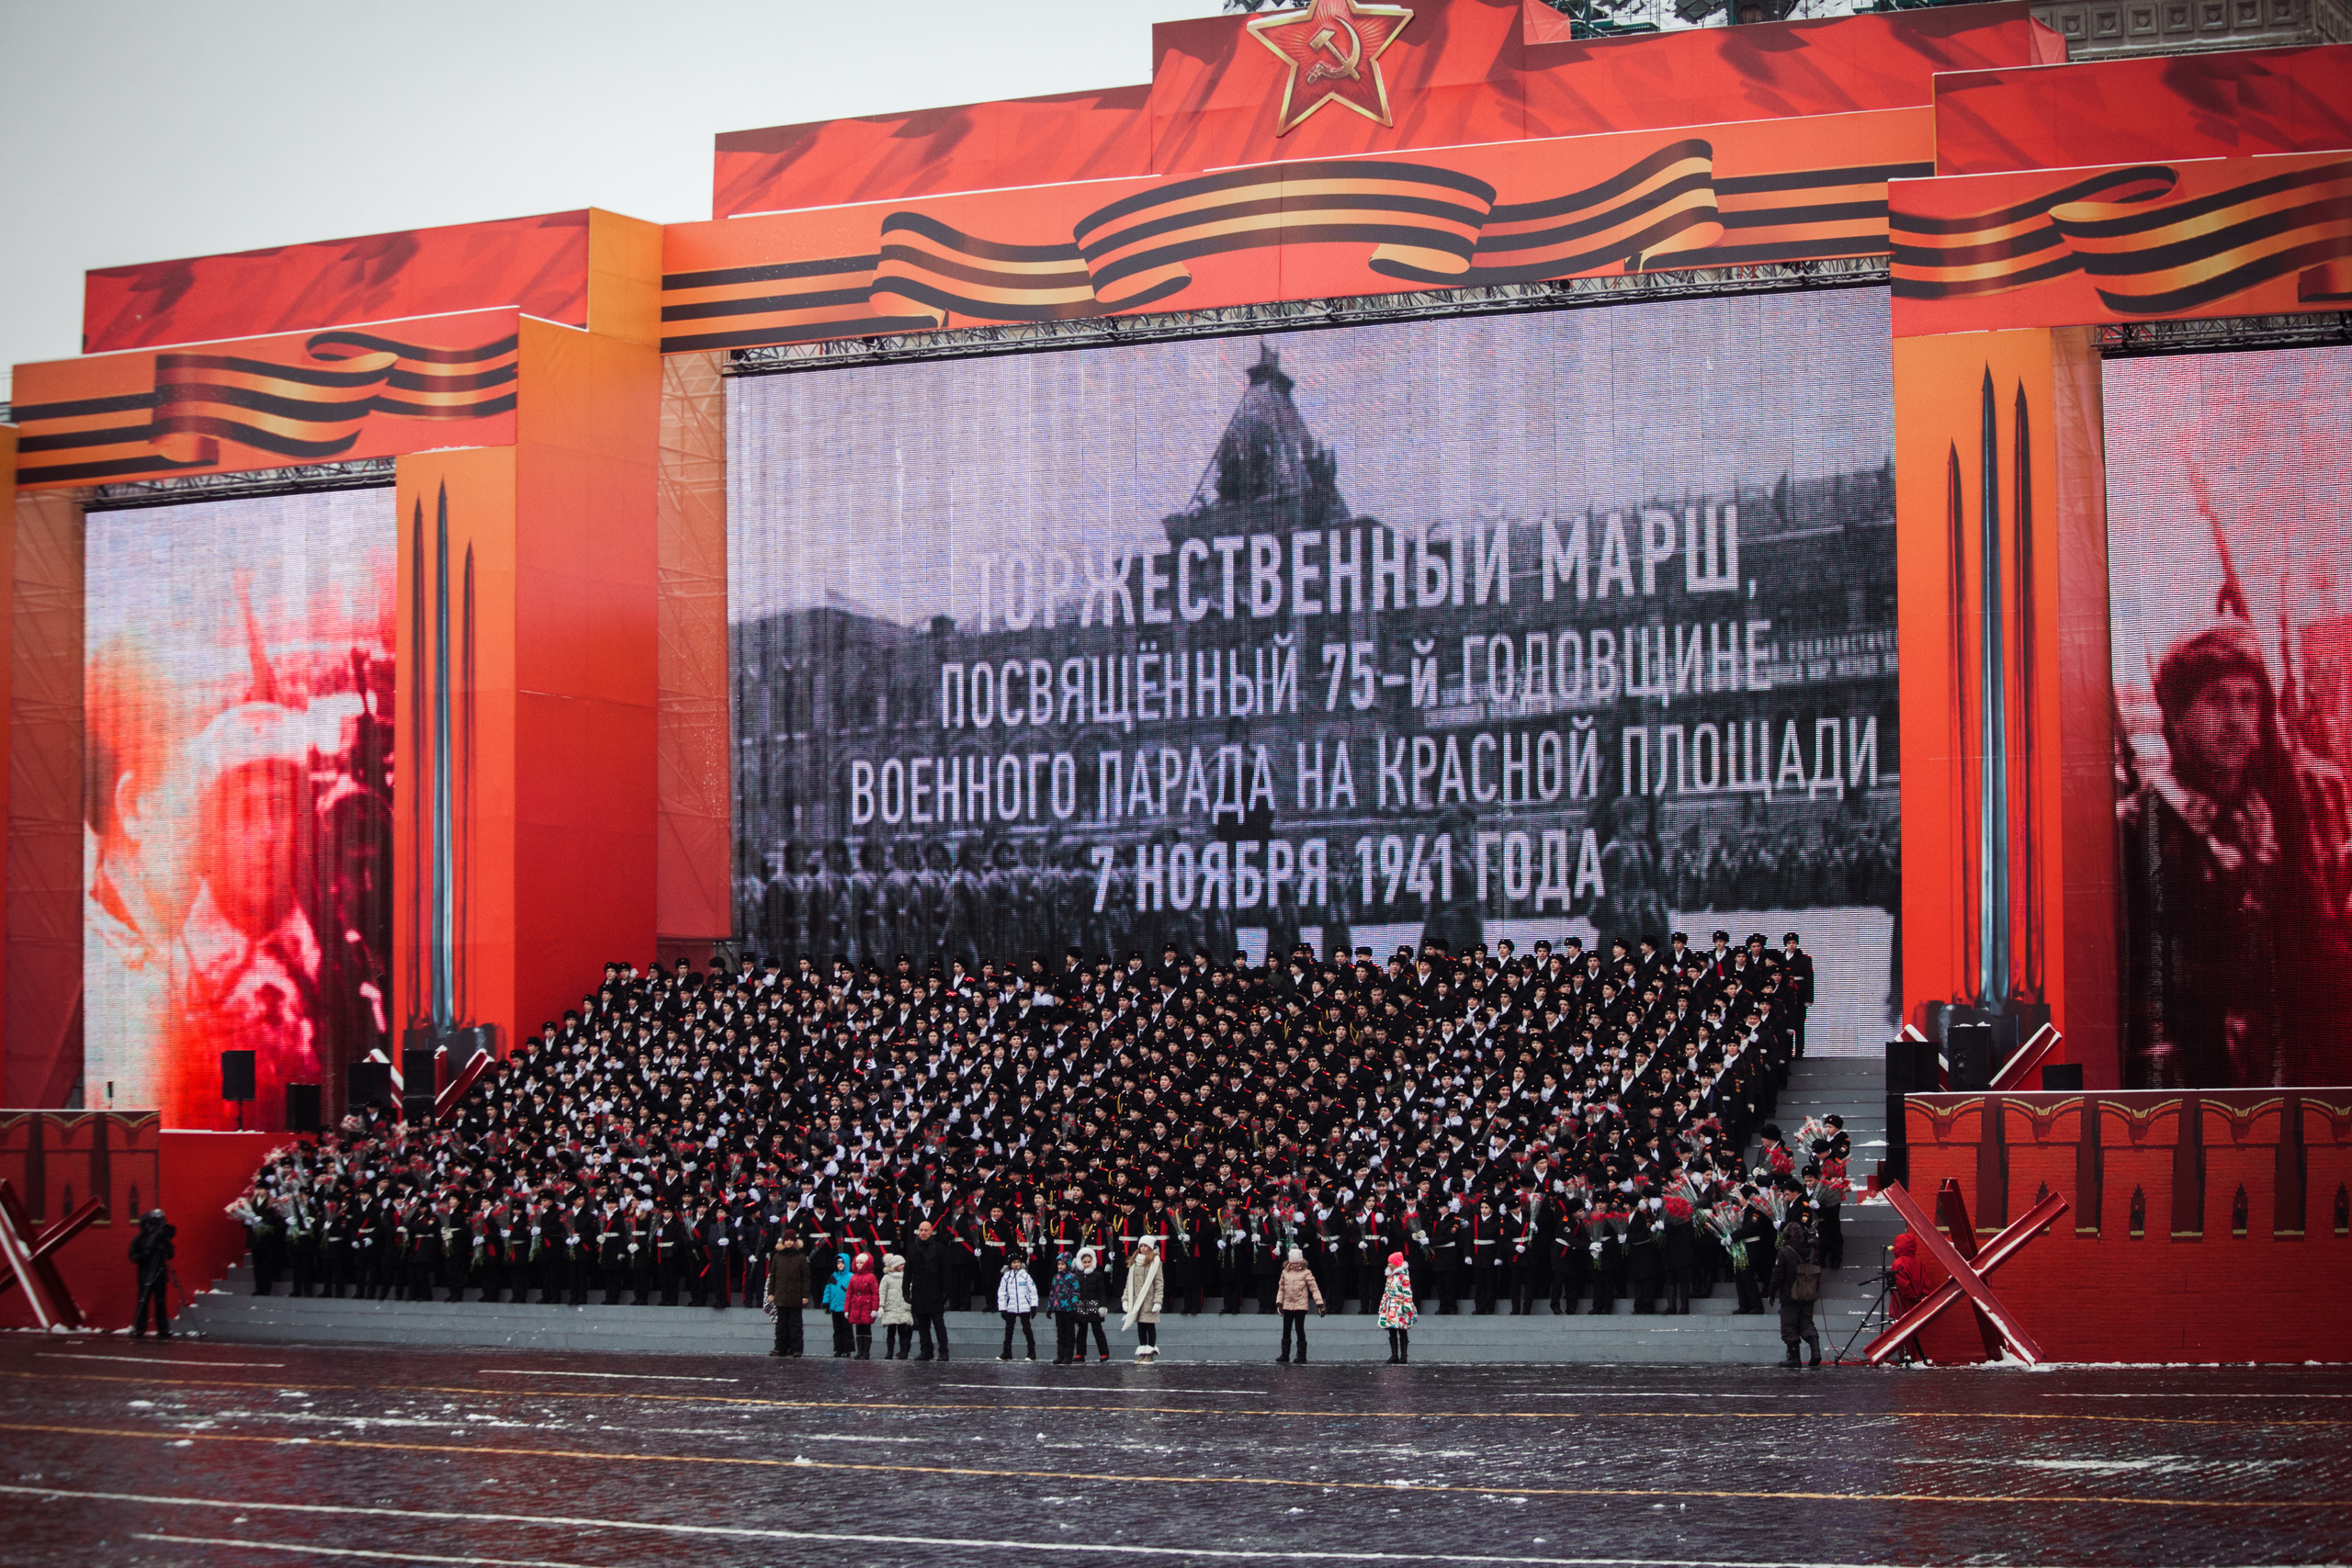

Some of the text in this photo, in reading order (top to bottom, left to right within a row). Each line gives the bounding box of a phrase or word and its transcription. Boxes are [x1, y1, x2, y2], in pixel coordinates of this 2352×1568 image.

[1542, 504, 1757, 600] МАРШ,
[941, 633, 1298, 733] ПОСВЯЩЁННЫЙ
[1462, 620, 1771, 712] ГОДОВЩИНЕ
[851, 716, 1879, 825] ВОЕННОГО ПАРАДА НА КРАСНОЙ ПЛОЩАДИ
[1091, 828, 1606, 913] 7 НОЯБРЯ 1941 ГОДА
